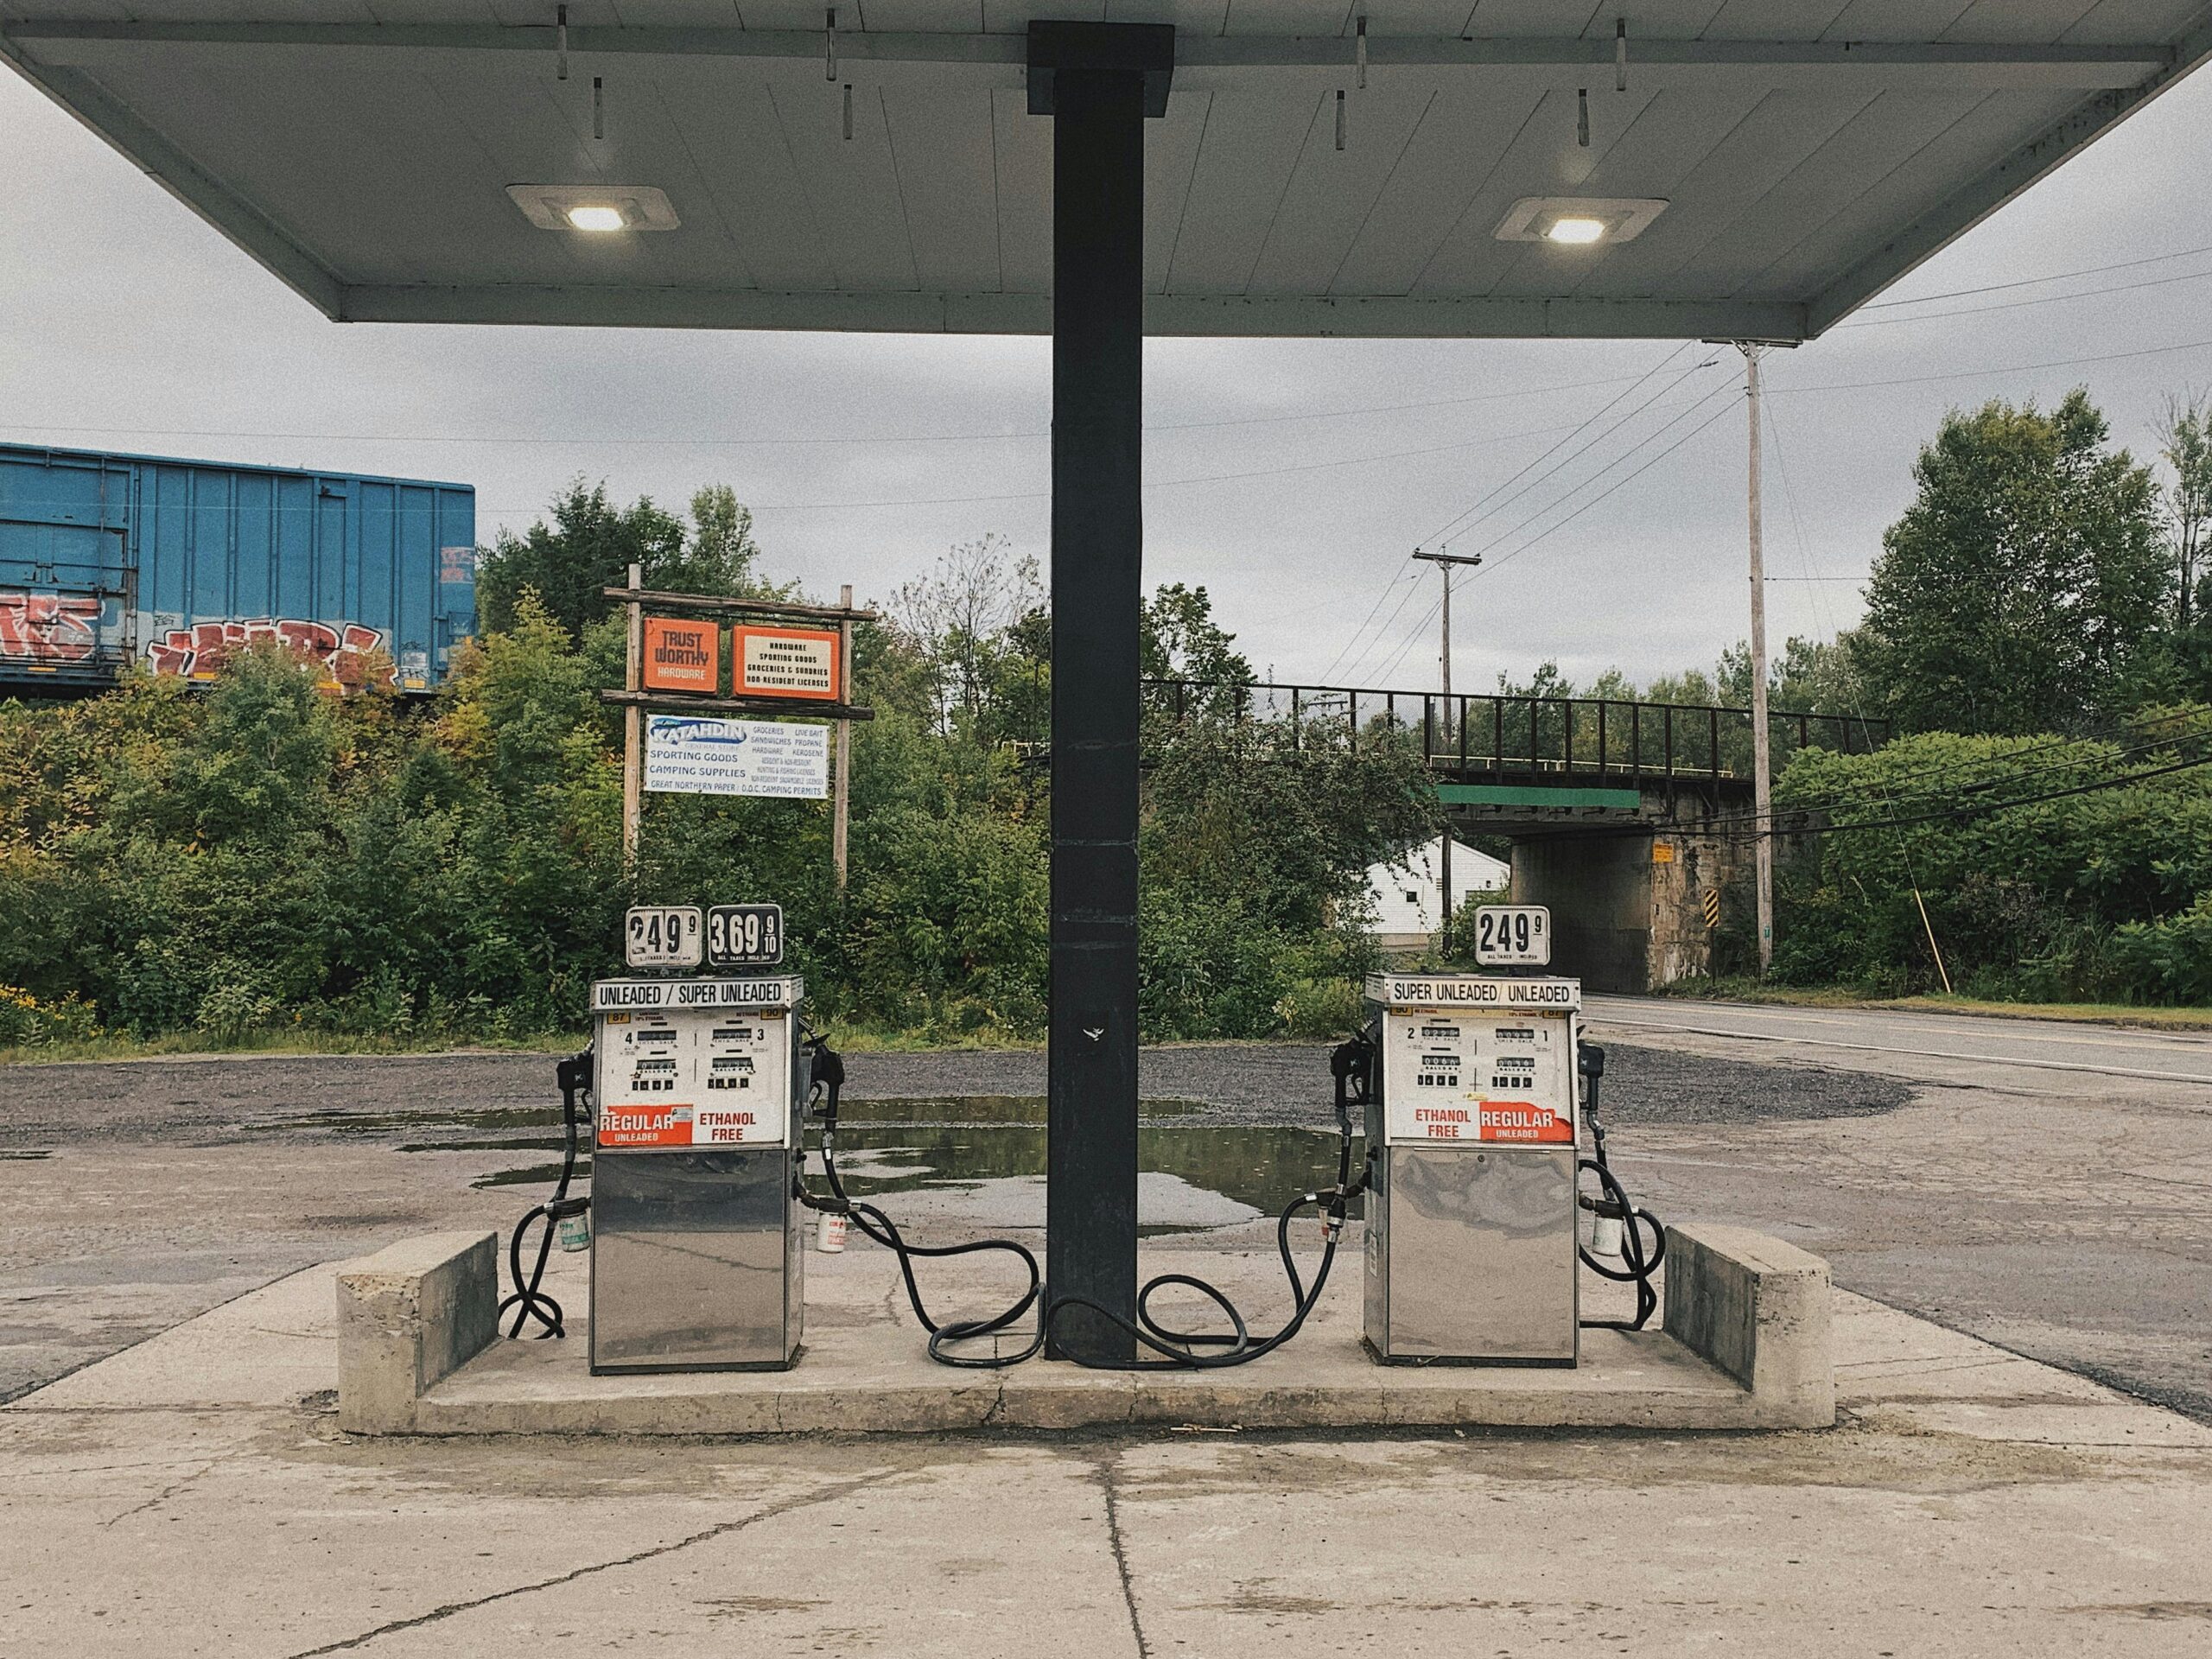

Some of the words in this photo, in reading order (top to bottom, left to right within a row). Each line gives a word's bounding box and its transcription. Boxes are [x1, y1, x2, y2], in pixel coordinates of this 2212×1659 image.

[662, 631, 703, 648] TRUST
[655, 648, 709, 666] WORTHY
[760, 653, 792, 662] SPORTING
[658, 666, 706, 680] HARDWARE
[747, 664, 785, 673] GROCERIES
[796, 667, 828, 676] SUNDRIES
[798, 678, 829, 687] LICENSES
[652, 723, 743, 742] KATAHDIN
[650, 750, 701, 760] SPORTING
[704, 753, 738, 762] GOODS
[650, 766, 696, 775] CAMPING
[699, 767, 746, 778] SUPPLIES
[675, 781, 713, 790] NORTHERN
[762, 785, 791, 794] CAMPING
[600, 986, 660, 1005] UNLEADED
[666, 984, 673, 1005] /
[678, 984, 716, 1003] SUPER
[721, 982, 781, 1002] UNLEADED
[1395, 982, 1432, 1000] SUPER
[1509, 985, 1570, 1002] UNLEADED
[613, 1013, 626, 1021] 87
[625, 1032, 632, 1044] 4
[757, 1028, 764, 1040] 3
[1408, 1027, 1414, 1039] 2
[1543, 1030, 1548, 1041] 1
[700, 1112, 756, 1125] ETHANOL
[1415, 1109, 1471, 1122] ETHANOL
[1480, 1110, 1554, 1128] REGULAR
[600, 1114, 674, 1131] REGULAR
[712, 1128, 743, 1141] FREE
[1428, 1125, 1459, 1137] FREE
[1497, 1129, 1538, 1139] UNLEADED
[614, 1133, 658, 1142] UNLEADED
